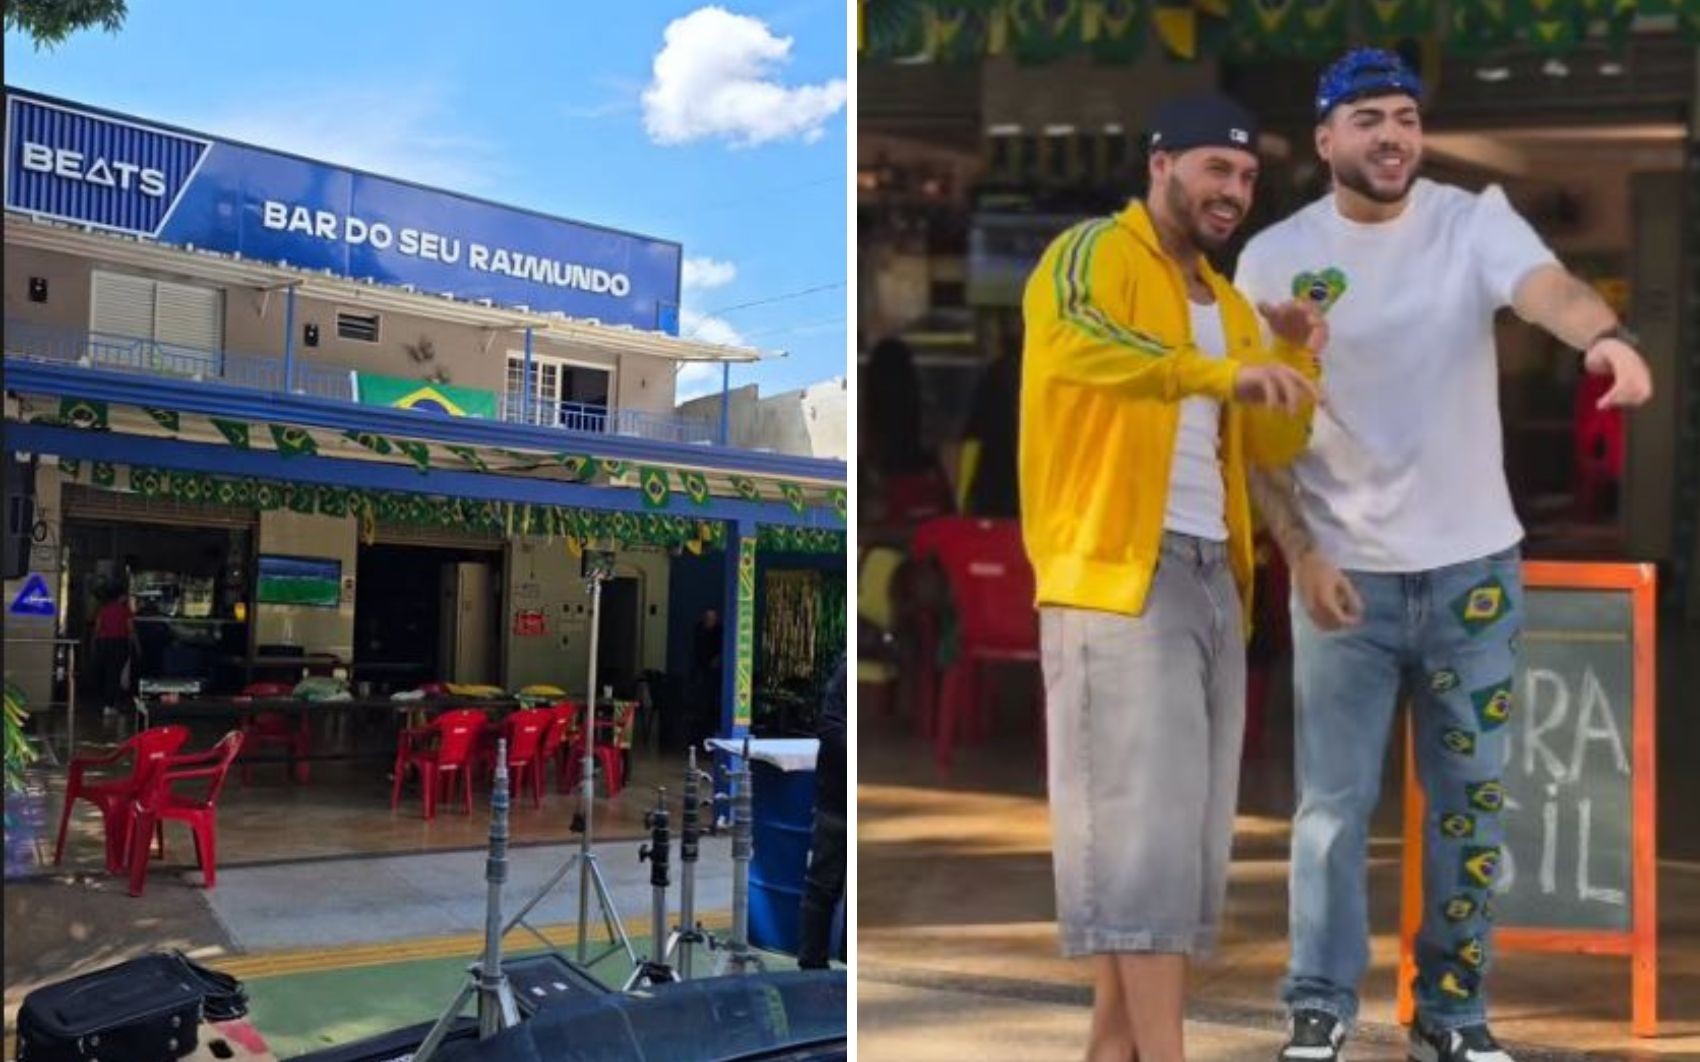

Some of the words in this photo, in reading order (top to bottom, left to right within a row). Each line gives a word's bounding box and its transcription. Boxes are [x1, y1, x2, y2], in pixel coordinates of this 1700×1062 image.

[22, 142, 166, 197] BEATS
[263, 201, 338, 240] BAR
[344, 217, 393, 250] DO
[399, 229, 461, 265] SEU
[468, 243, 631, 298] RAIMUNDO
[1503, 666, 1631, 781] RA
